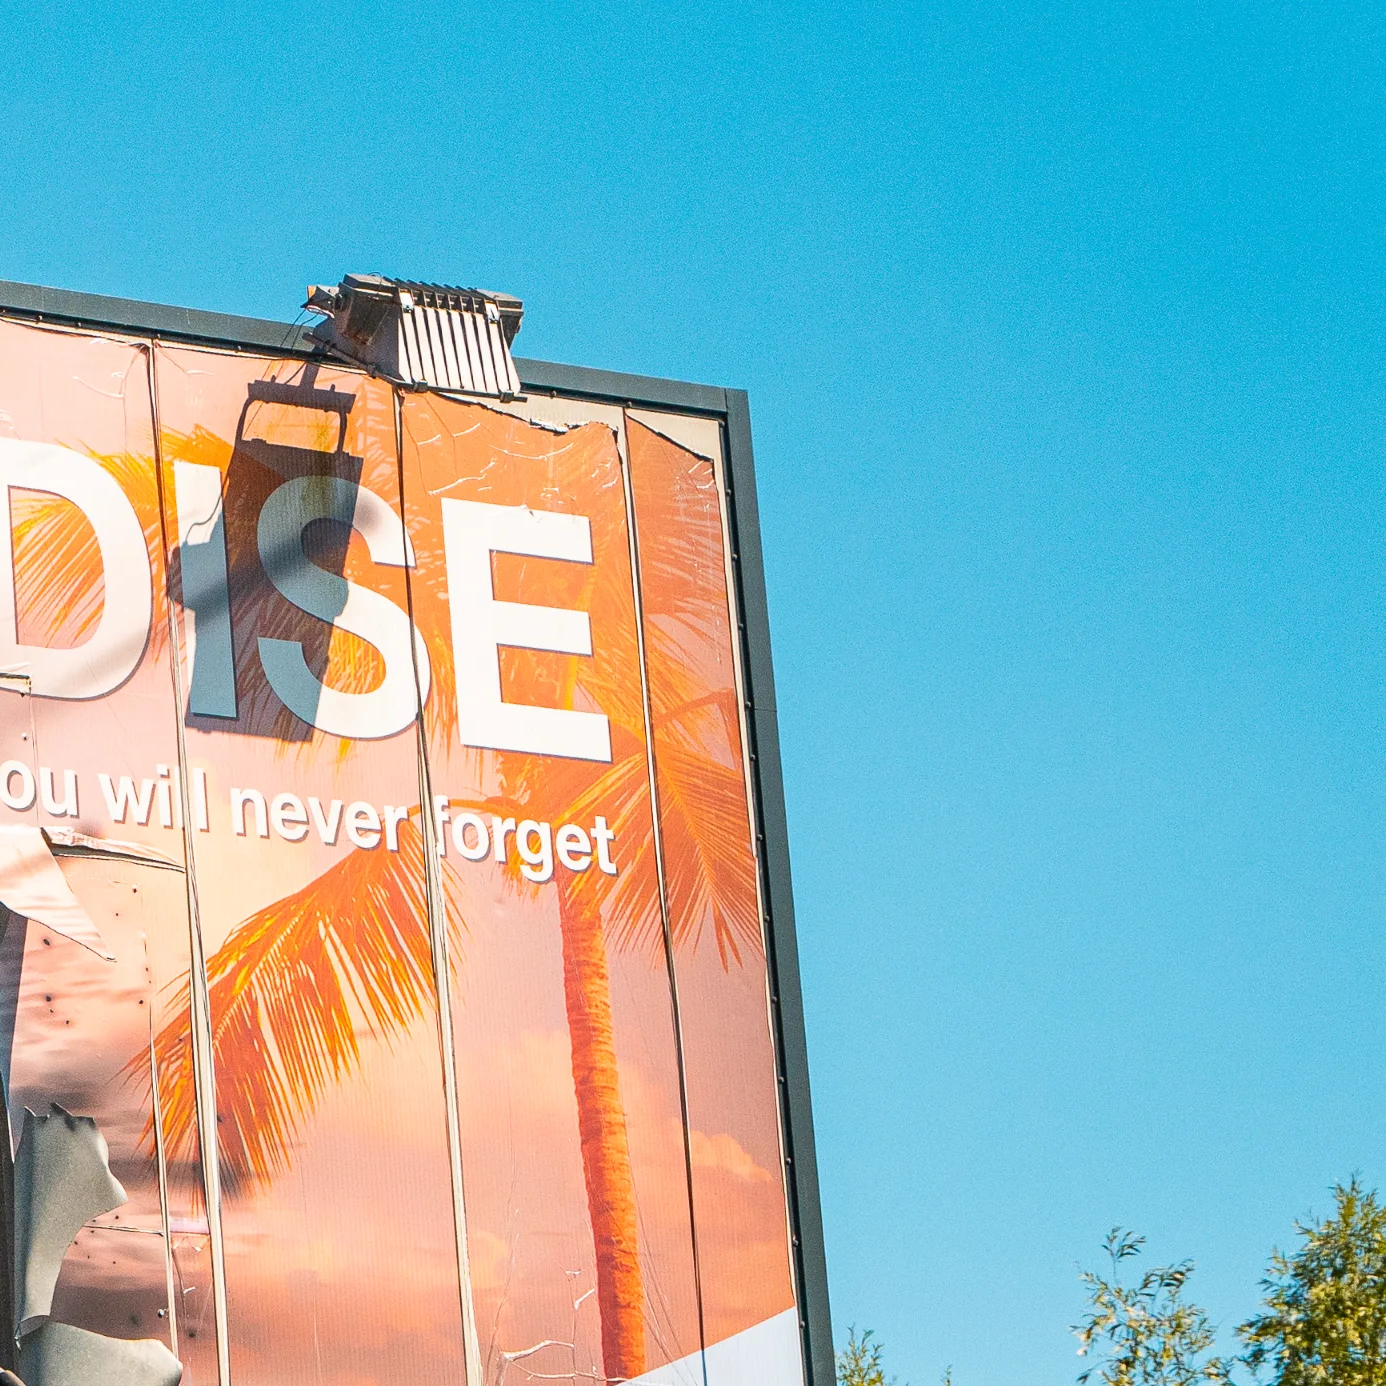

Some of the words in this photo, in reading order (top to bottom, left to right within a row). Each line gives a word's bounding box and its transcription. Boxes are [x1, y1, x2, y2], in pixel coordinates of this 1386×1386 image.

[97, 763, 210, 832] will
[230, 787, 410, 852] never
[431, 795, 619, 884] forget
